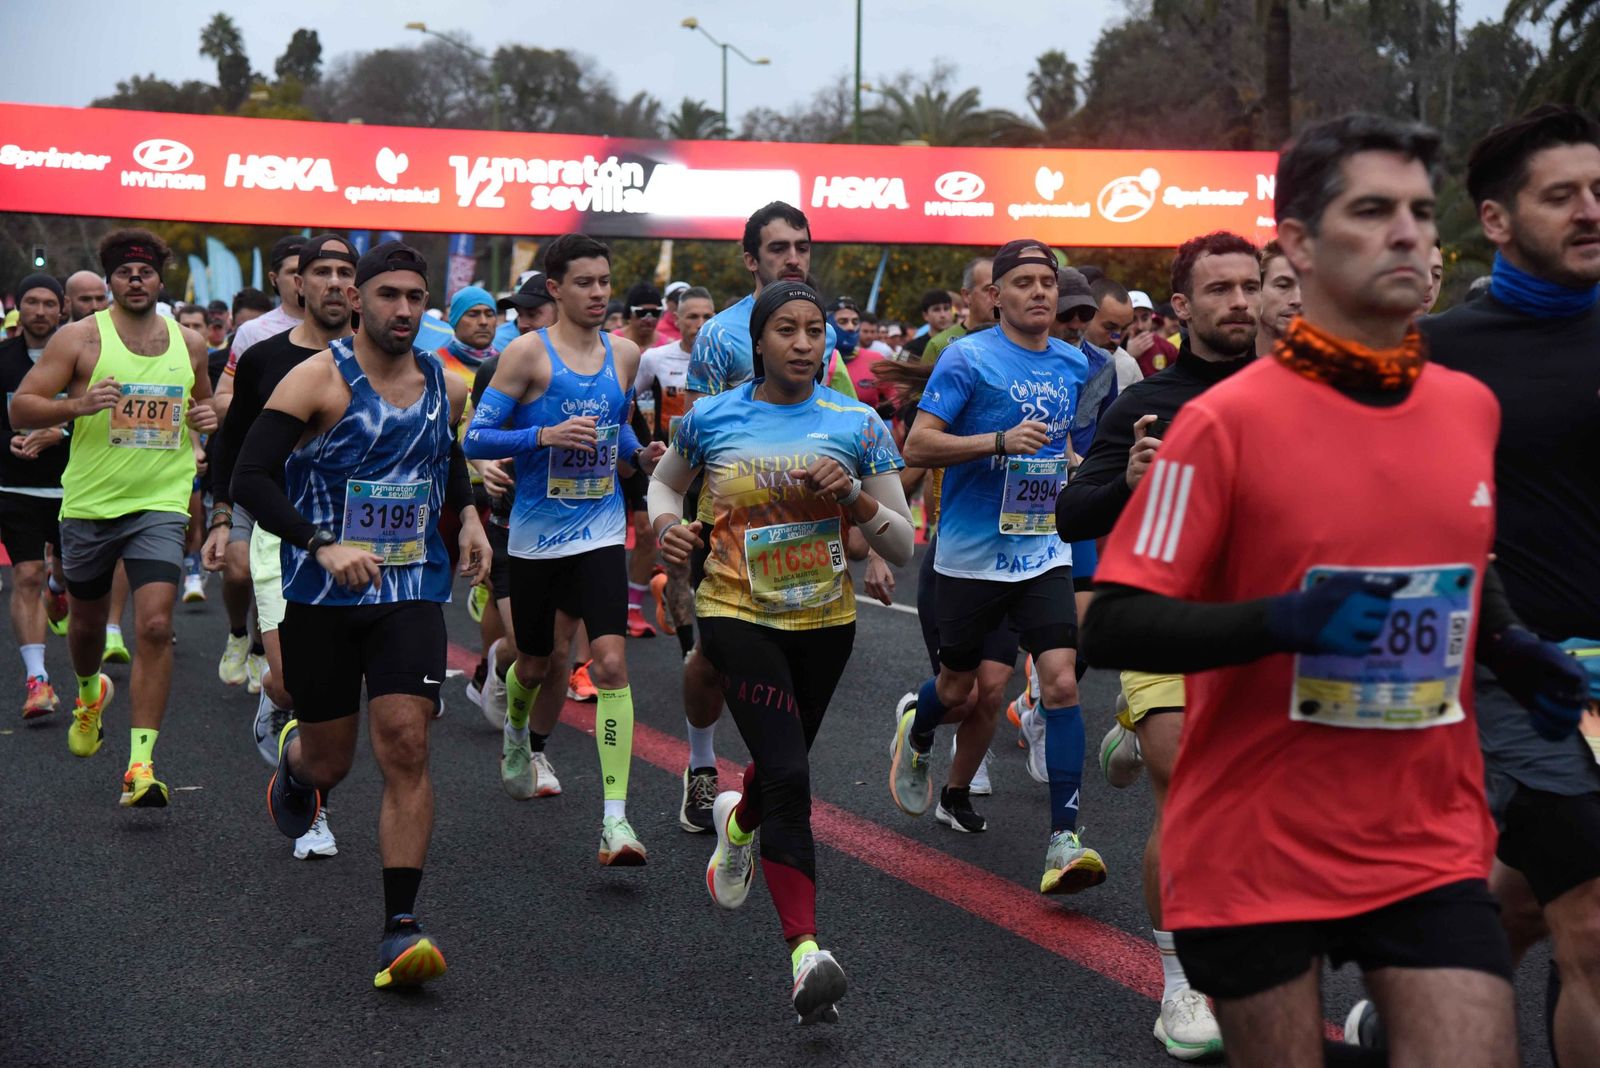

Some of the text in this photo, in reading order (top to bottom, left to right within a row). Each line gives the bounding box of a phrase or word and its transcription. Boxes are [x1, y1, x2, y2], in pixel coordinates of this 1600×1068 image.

[120, 171, 206, 191] HYUNDAI
[224, 154, 339, 192] HOKA
[811, 176, 909, 209] HOKA
[924, 202, 994, 217] HYUNDAI
[789, 291, 816, 300] KIPRUN
[122, 399, 169, 419] 4787
[562, 445, 608, 468] 2993
[737, 451, 819, 476] MEDIO
[1016, 479, 1058, 501] 2994
[360, 503, 415, 529] 3195
[757, 540, 830, 577] 11658
[995, 546, 1058, 574] BAEZA
[1370, 608, 1438, 656] 86
[737, 681, 800, 719] ACTIV
